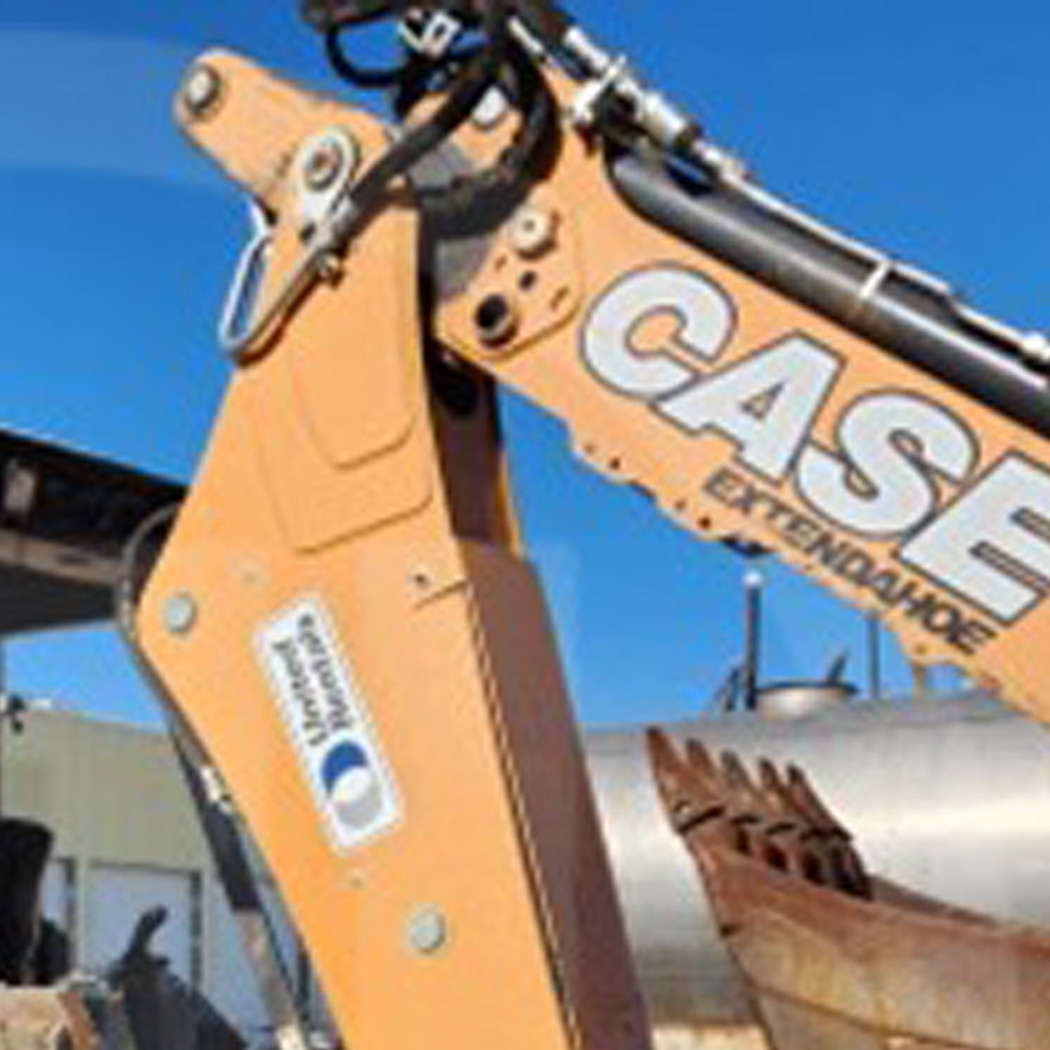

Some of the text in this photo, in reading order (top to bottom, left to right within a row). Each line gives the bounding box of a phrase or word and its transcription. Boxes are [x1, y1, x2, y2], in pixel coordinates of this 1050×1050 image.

[579, 261, 1050, 627] CASE
[703, 467, 997, 656] EXTENDAHOE
[271, 637, 328, 746] United
[297, 613, 352, 729] Rentals
